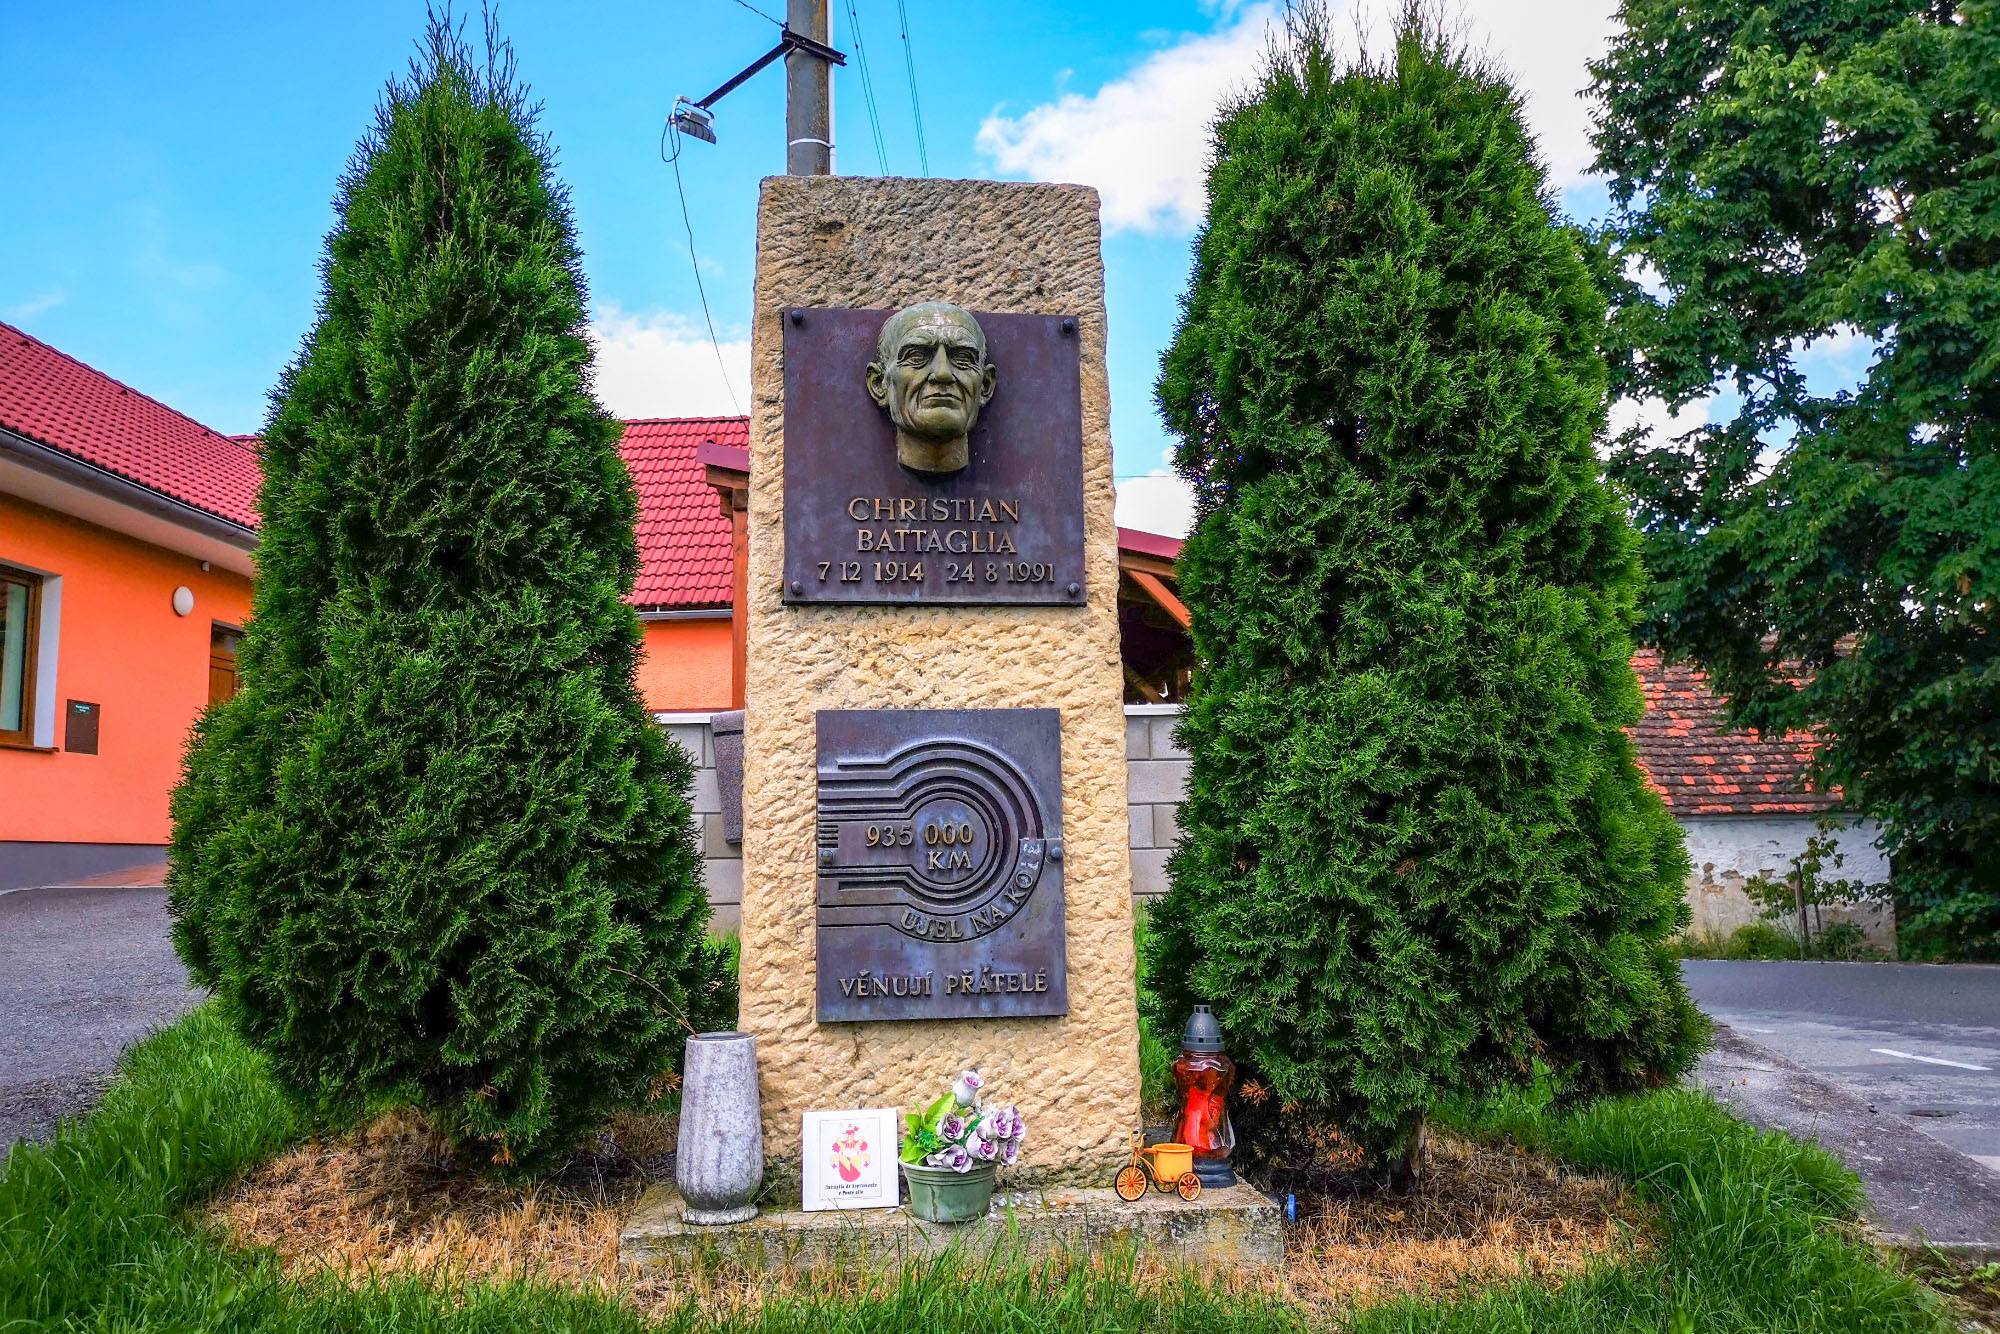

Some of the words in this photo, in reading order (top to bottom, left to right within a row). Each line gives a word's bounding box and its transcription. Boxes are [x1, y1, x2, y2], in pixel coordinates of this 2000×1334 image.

[848, 498, 1020, 523] CHRISTIAN
[856, 528, 1017, 554] BATTAGLIA
[817, 561, 832, 581] 7
[839, 561, 861, 581] 12
[873, 561, 925, 582] 1914
[946, 561, 976, 582] 24
[985, 562, 998, 582] 8
[1006, 562, 1056, 582] 1991
[864, 824, 913, 848] 935
[924, 822, 974, 845] 000
[927, 850, 974, 872] KM
[901, 909, 965, 939] UJEL
[968, 903, 1009, 933] NA
[838, 969, 933, 998] VĚNUJÍ
[945, 967, 1049, 996] PŘÁTELÉ
